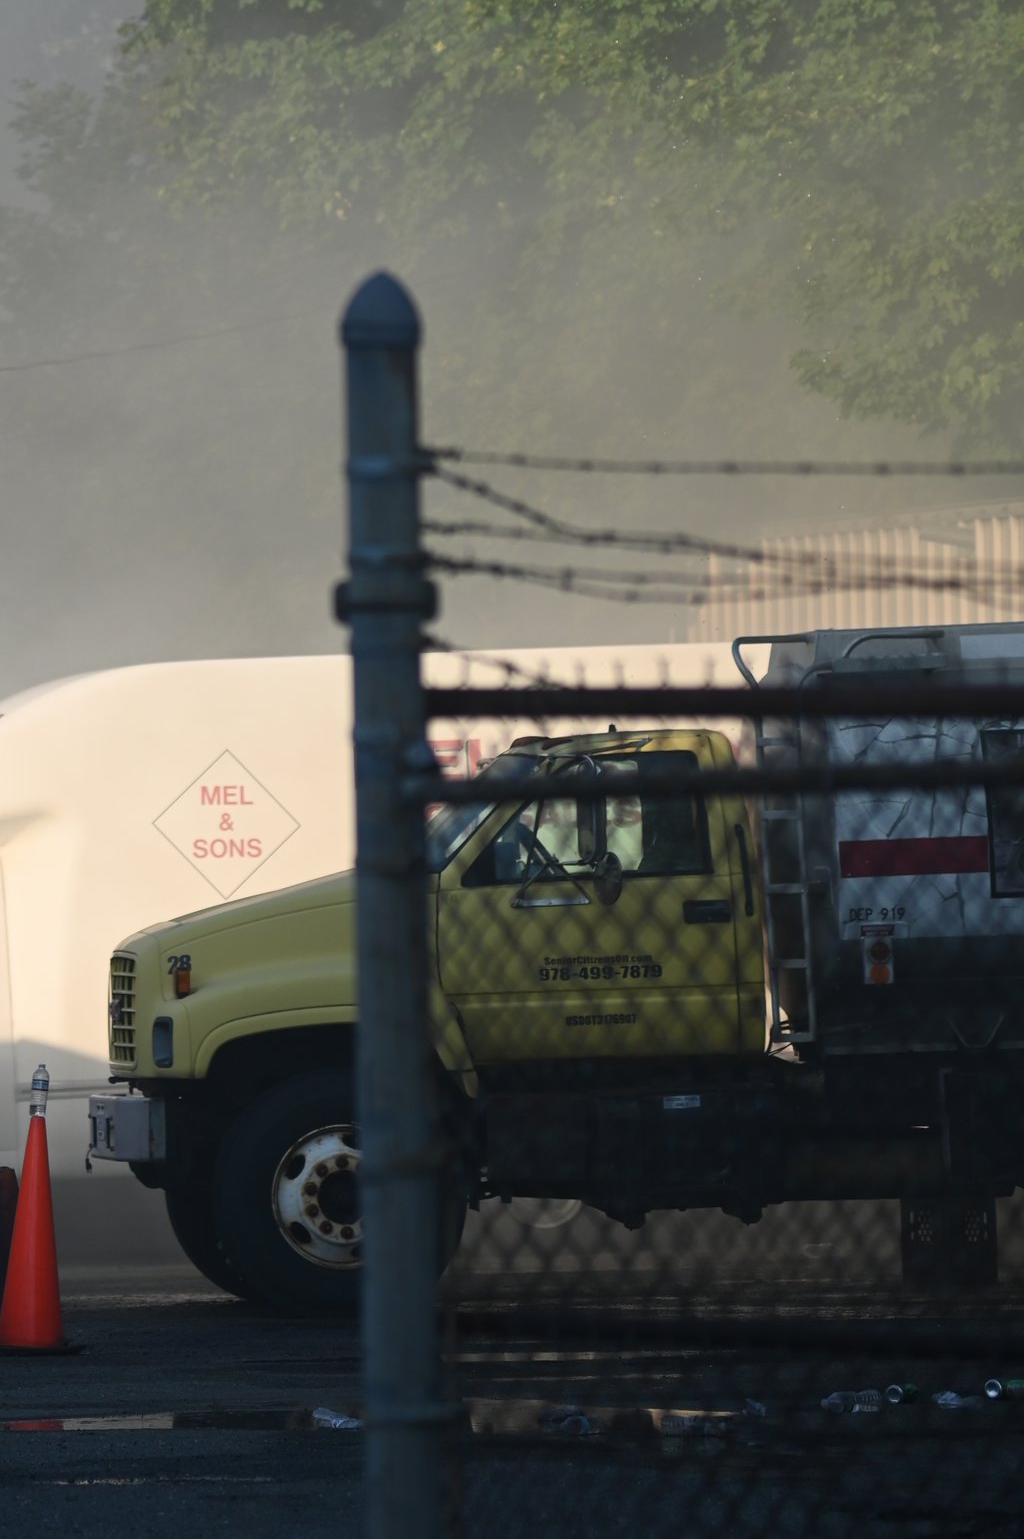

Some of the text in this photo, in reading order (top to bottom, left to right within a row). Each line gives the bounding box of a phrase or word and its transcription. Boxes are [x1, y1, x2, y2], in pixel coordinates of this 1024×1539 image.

[200, 785, 253, 806] MEL
[219, 812, 234, 832] &
[193, 838, 263, 859] SONS
[849, 907, 906, 921] DEP 919
[539, 965, 663, 981] 978-499-7879
